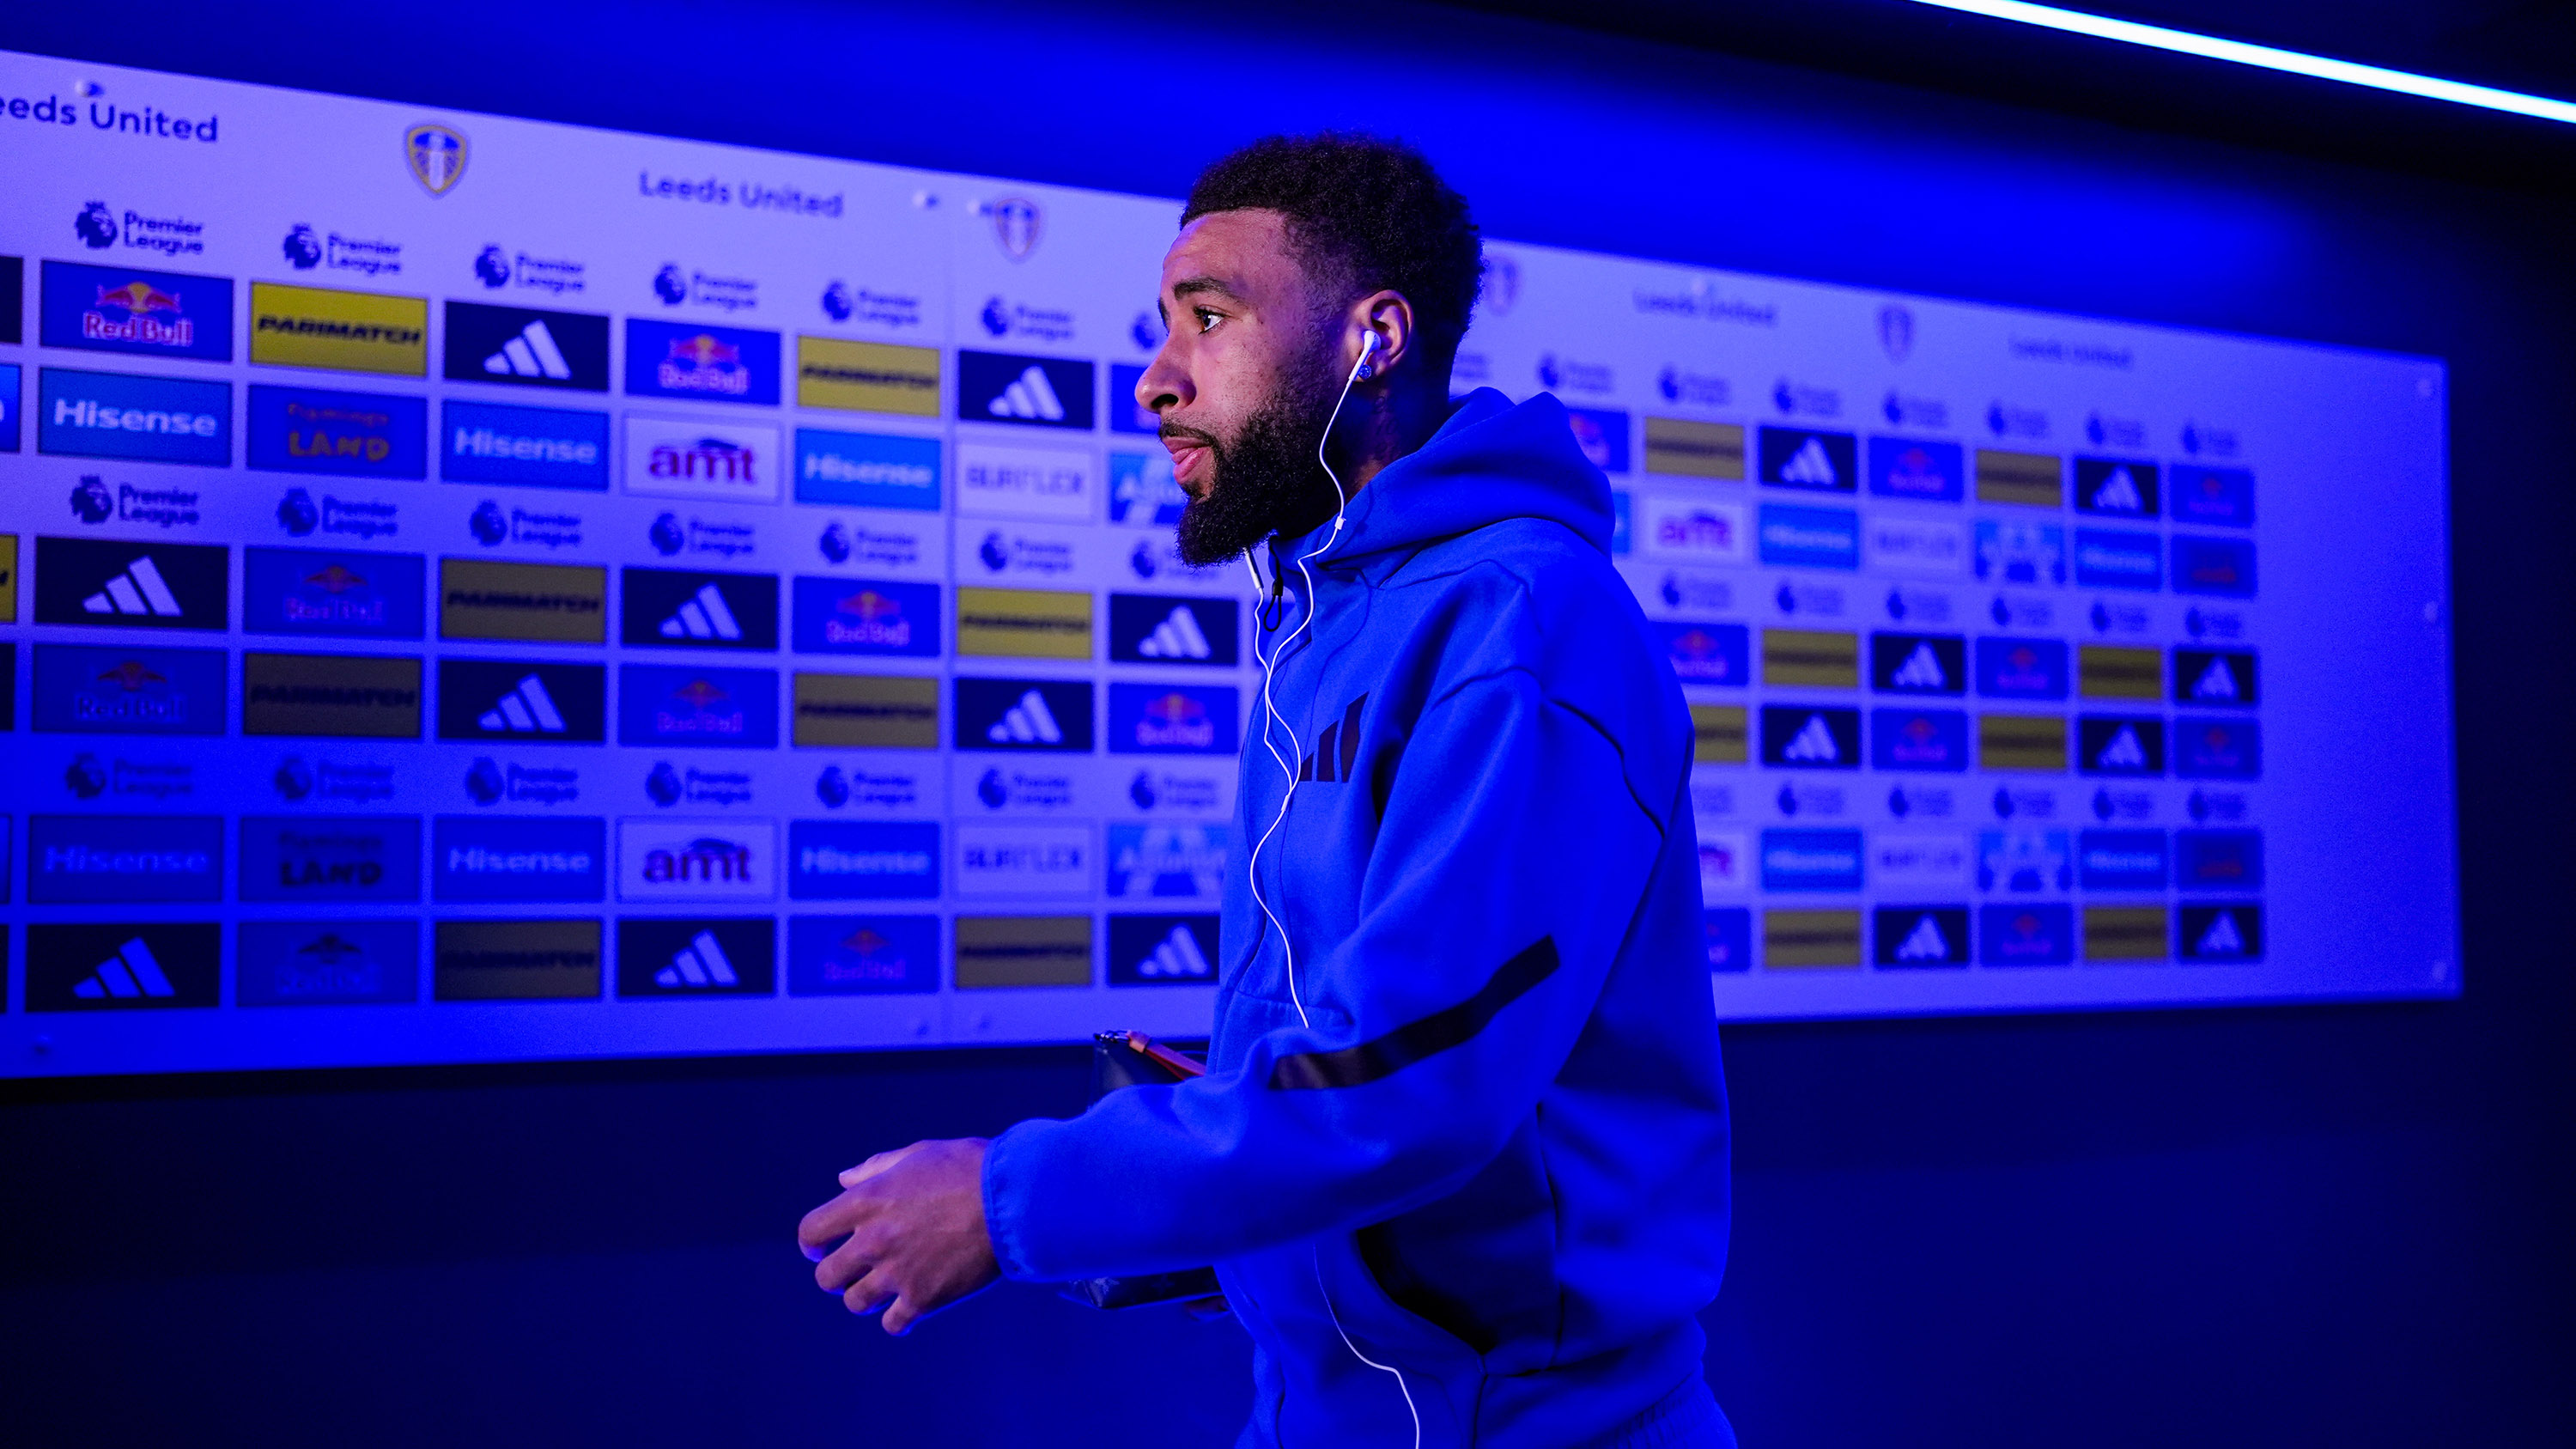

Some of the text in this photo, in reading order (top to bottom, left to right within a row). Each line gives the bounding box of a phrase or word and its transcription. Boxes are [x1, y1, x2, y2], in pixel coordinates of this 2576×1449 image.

[0, 92, 220, 144] eds United
[638, 167, 846, 221] Leeds United
[123, 209, 206, 236] Premier
[123, 228, 205, 257] League
[325, 230, 404, 256] Premier
[325, 251, 403, 277] League
[84, 312, 192, 346] Red Bull
[258, 314, 422, 345] PARIMATCH
[54, 399, 218, 436] Hisense
[288, 431, 390, 462] LAND
[453, 428, 599, 466] Hisense
[649, 445, 756, 484] amt
[119, 482, 199, 506] Premier
[119, 502, 200, 528] League
[45, 844, 209, 874] Hisense
[278, 859, 386, 889] LAND
[448, 847, 591, 873] Hisense
[642, 844, 752, 884] amt
